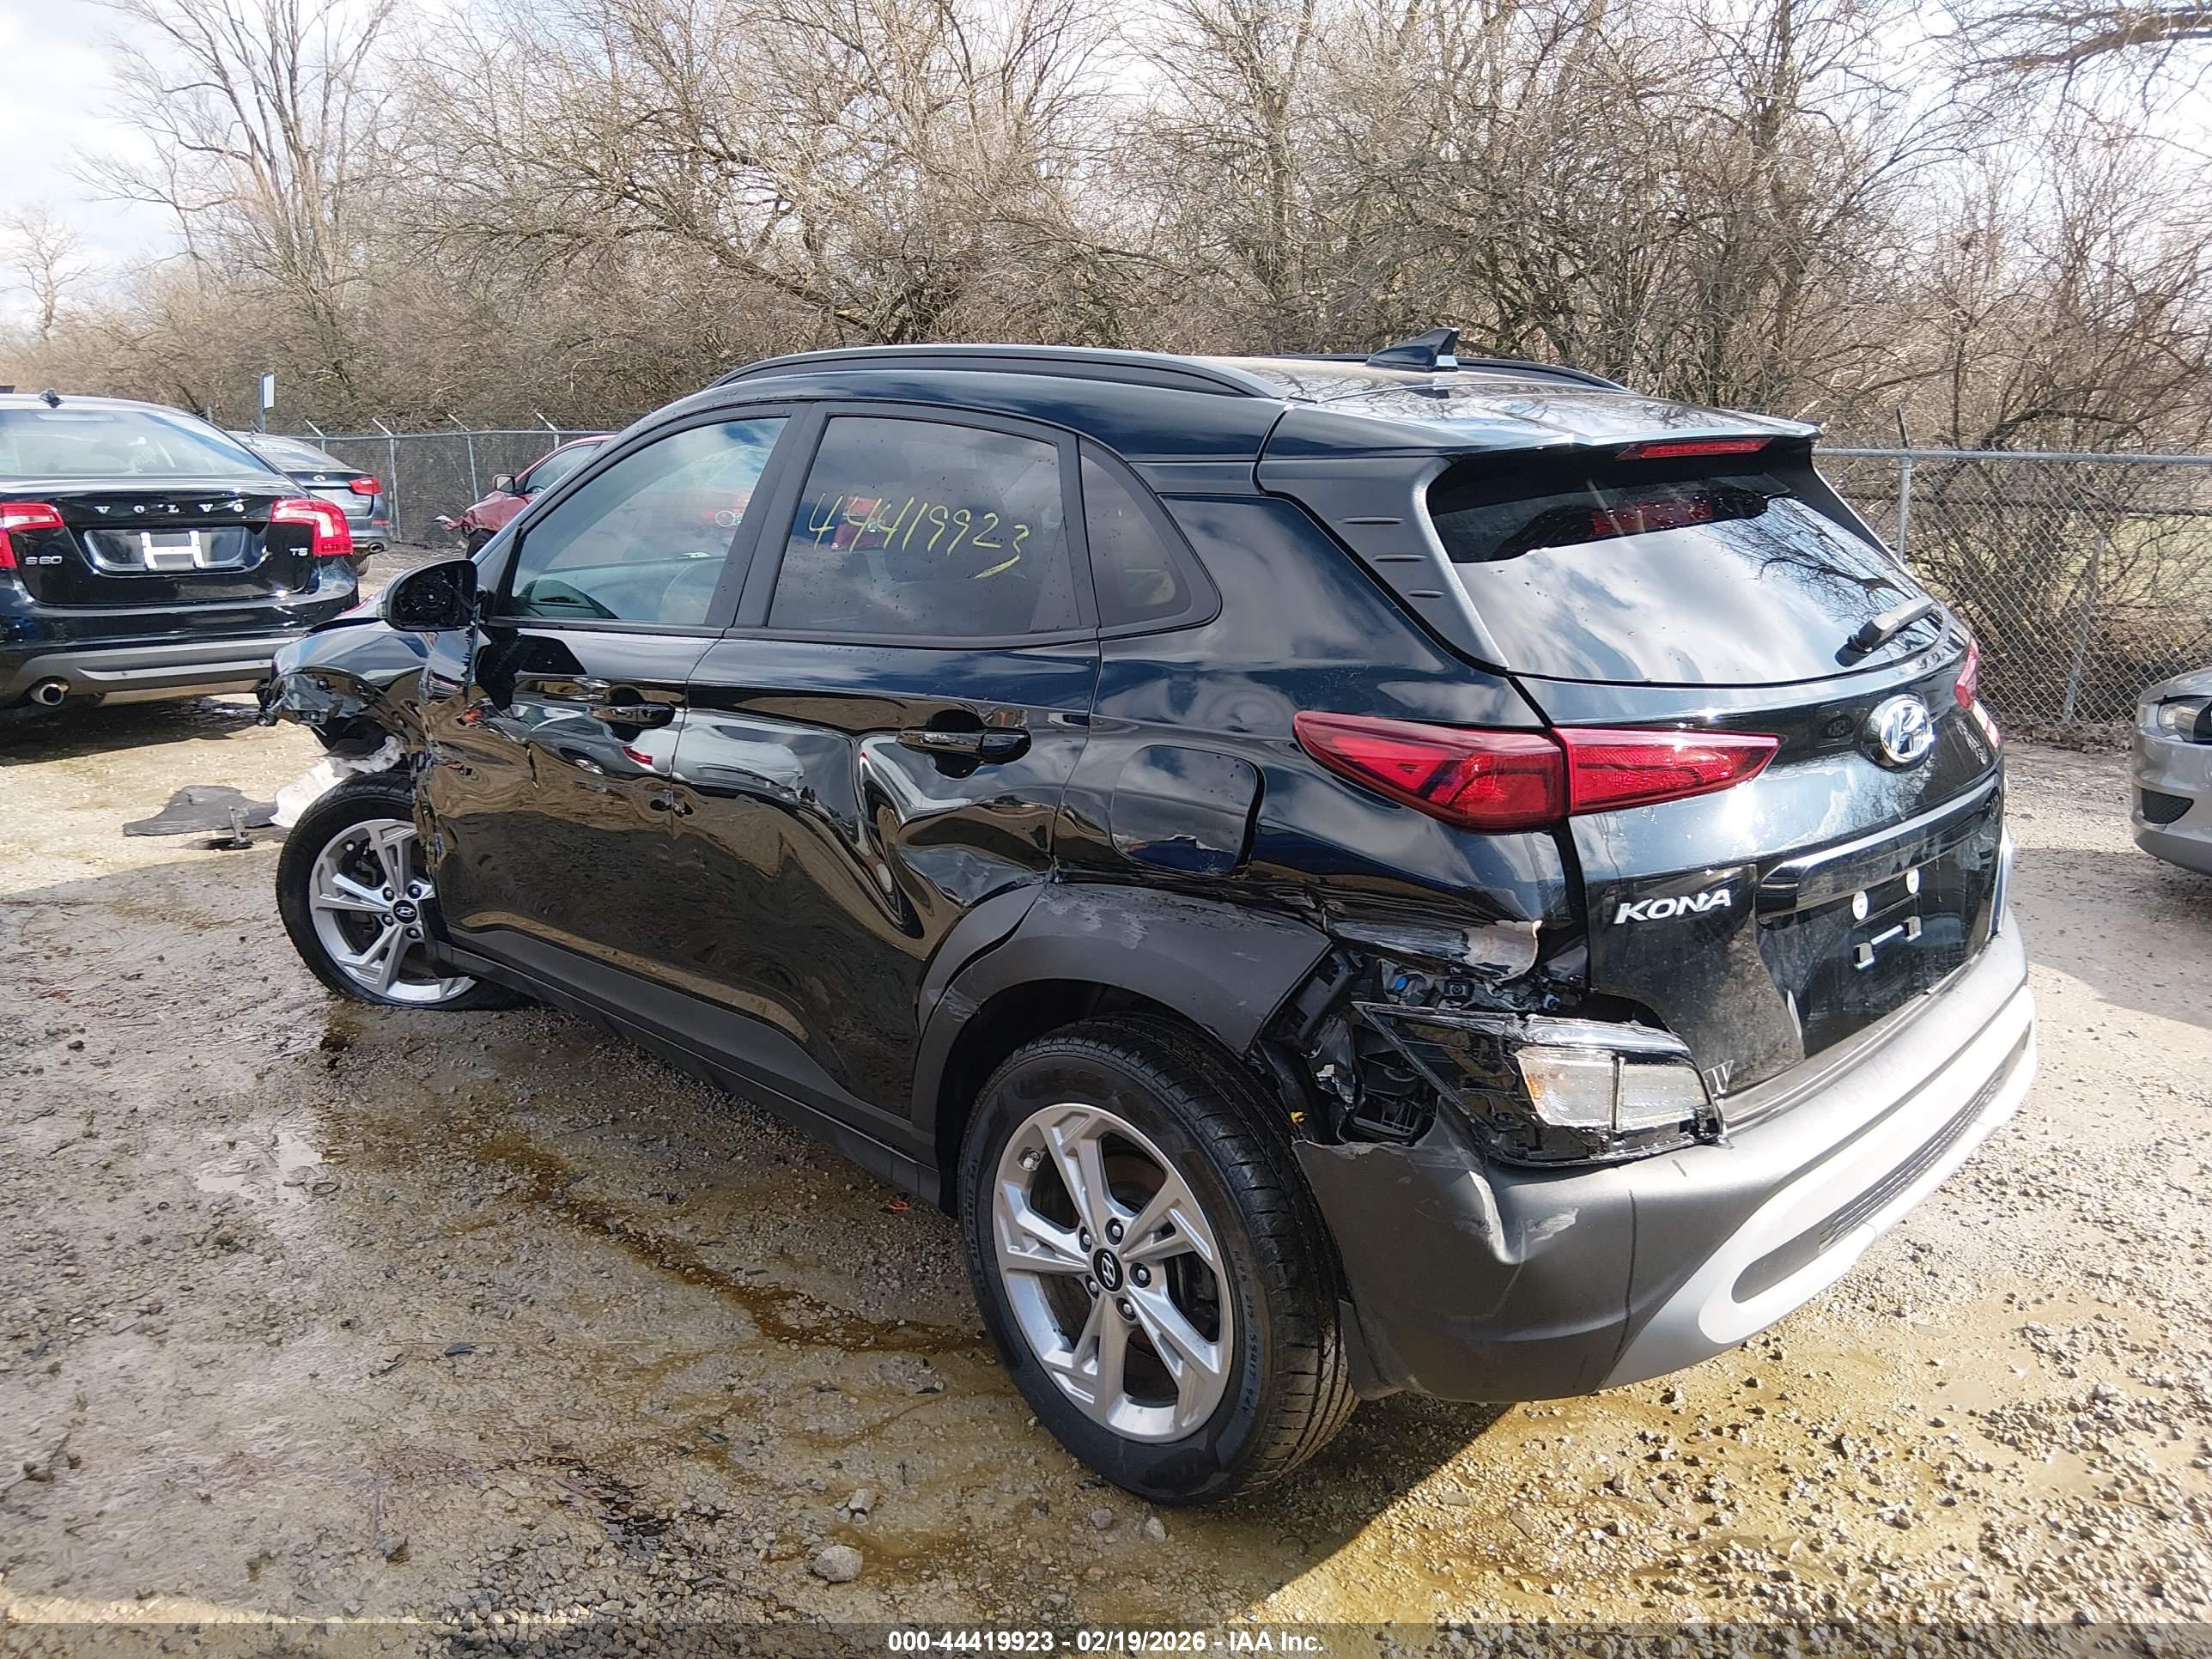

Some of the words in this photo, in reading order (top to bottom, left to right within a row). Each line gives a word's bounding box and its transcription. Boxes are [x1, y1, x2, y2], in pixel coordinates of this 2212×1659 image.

[94, 503, 246, 514] VOLVO
[808, 492, 1030, 580] 44419923
[289, 547, 309, 556] T5
[24, 555, 63, 566] S60
[1613, 889, 1731, 924] KONA
